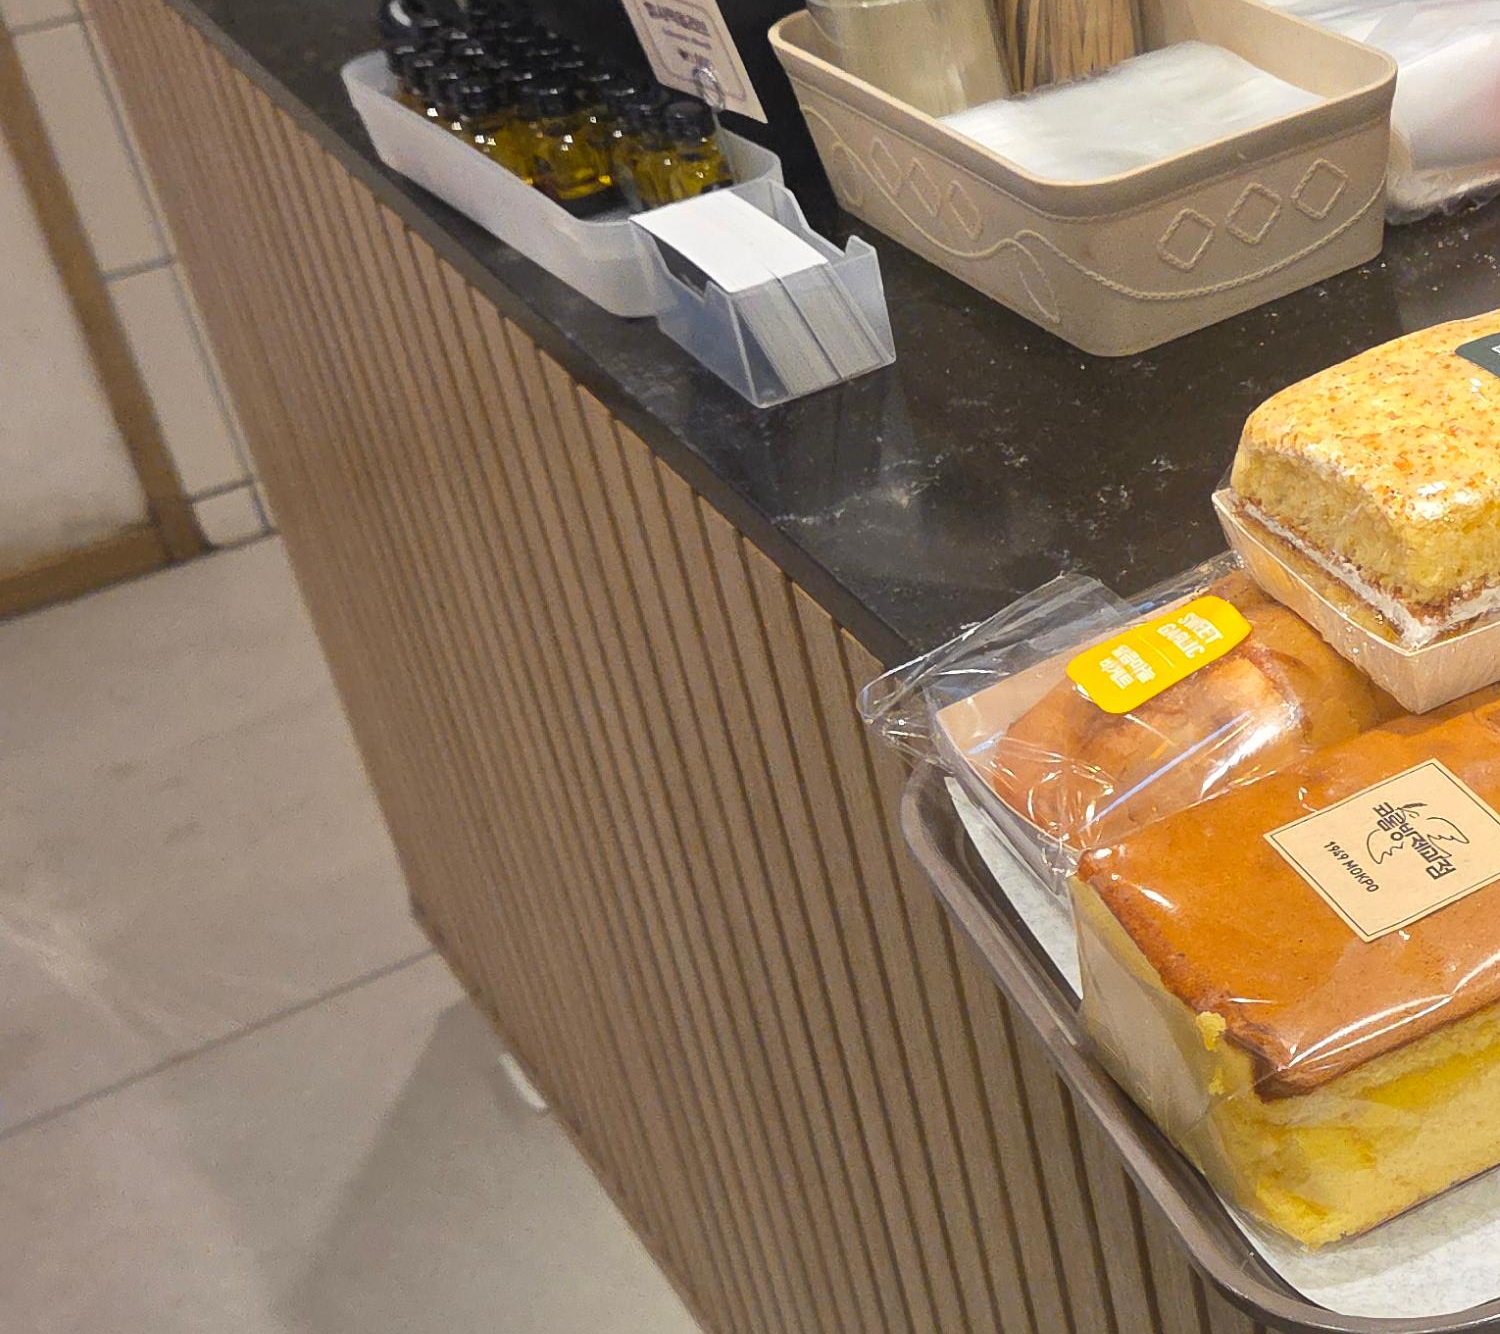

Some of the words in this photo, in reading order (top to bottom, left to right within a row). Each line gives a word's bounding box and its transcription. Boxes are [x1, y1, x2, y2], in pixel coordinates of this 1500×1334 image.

[1157, 623, 1206, 659] GARLIC
[1178, 612, 1224, 645] SWEET
[1372, 801, 1457, 880] 코롬방제과점
[1323, 840, 1349, 863] 1949
[1343, 859, 1379, 893] MOKPO
